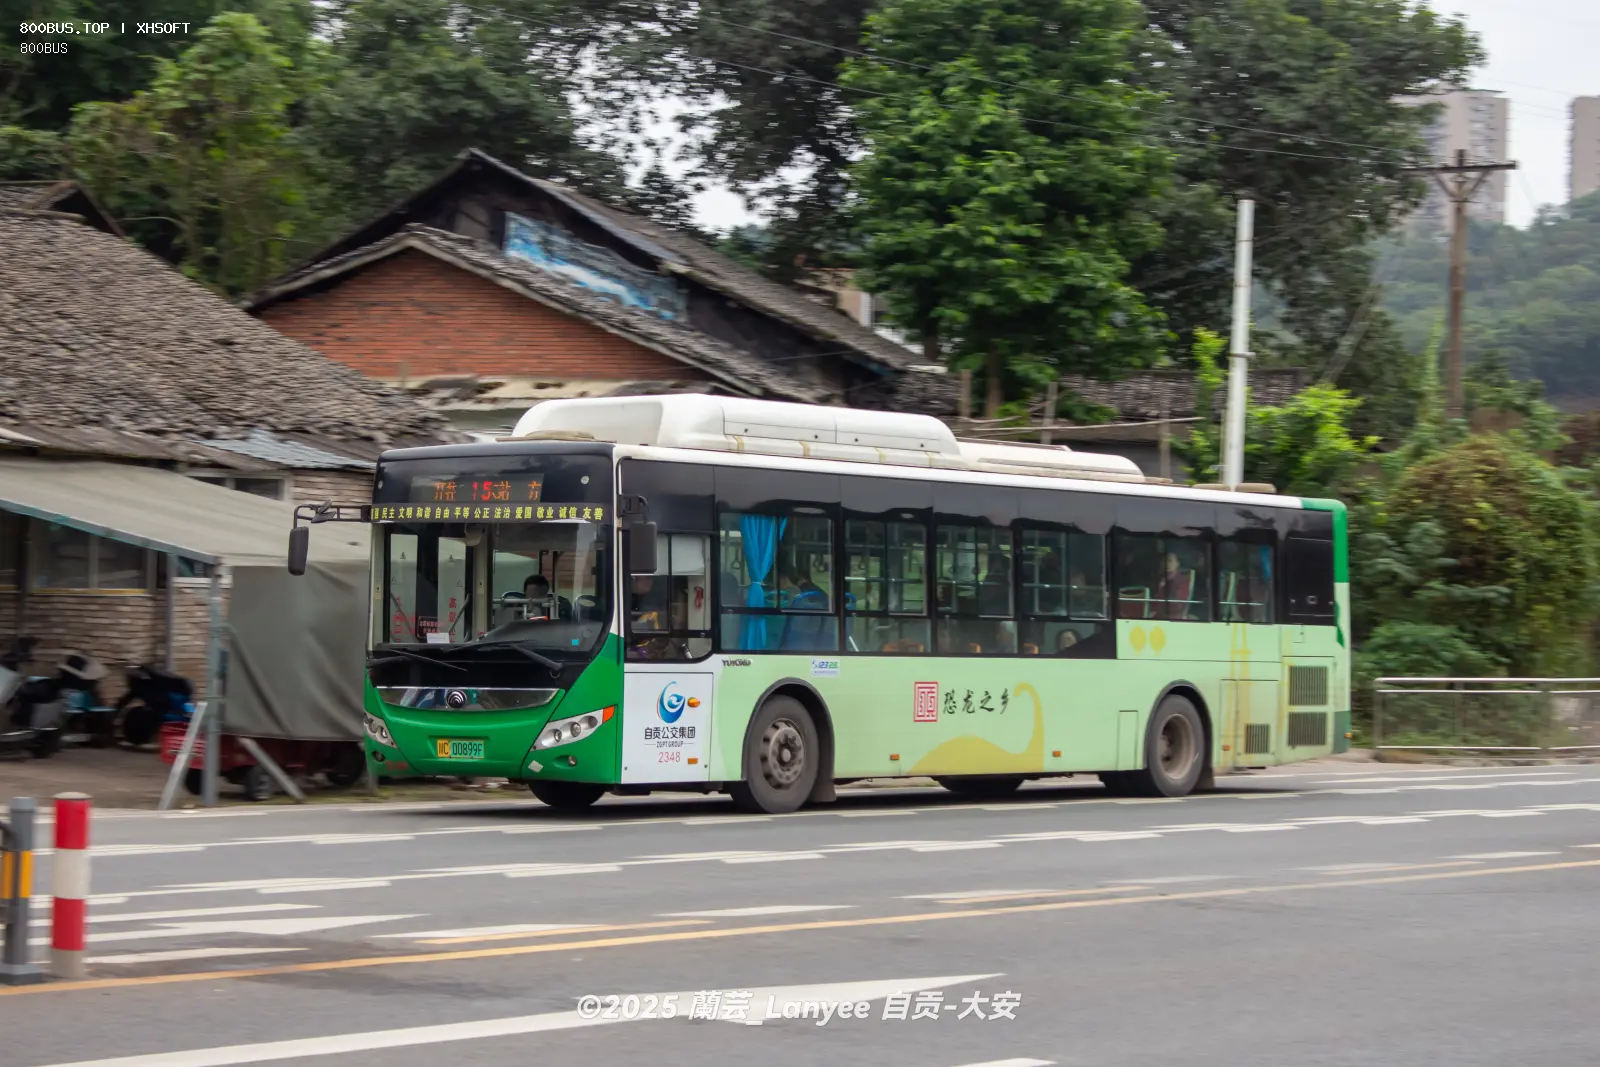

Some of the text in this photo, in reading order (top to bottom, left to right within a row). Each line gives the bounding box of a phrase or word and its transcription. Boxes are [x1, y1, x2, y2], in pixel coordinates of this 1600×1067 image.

[399, 507, 413, 519] 文明
[435, 507, 450, 519] 自由
[454, 507, 470, 519] 平等
[474, 507, 490, 519] 公正
[494, 507, 511, 519] 法治
[582, 507, 603, 520] 友善
[644, 726, 696, 740] 自贡公交集团
[658, 751, 681, 763] 2348
